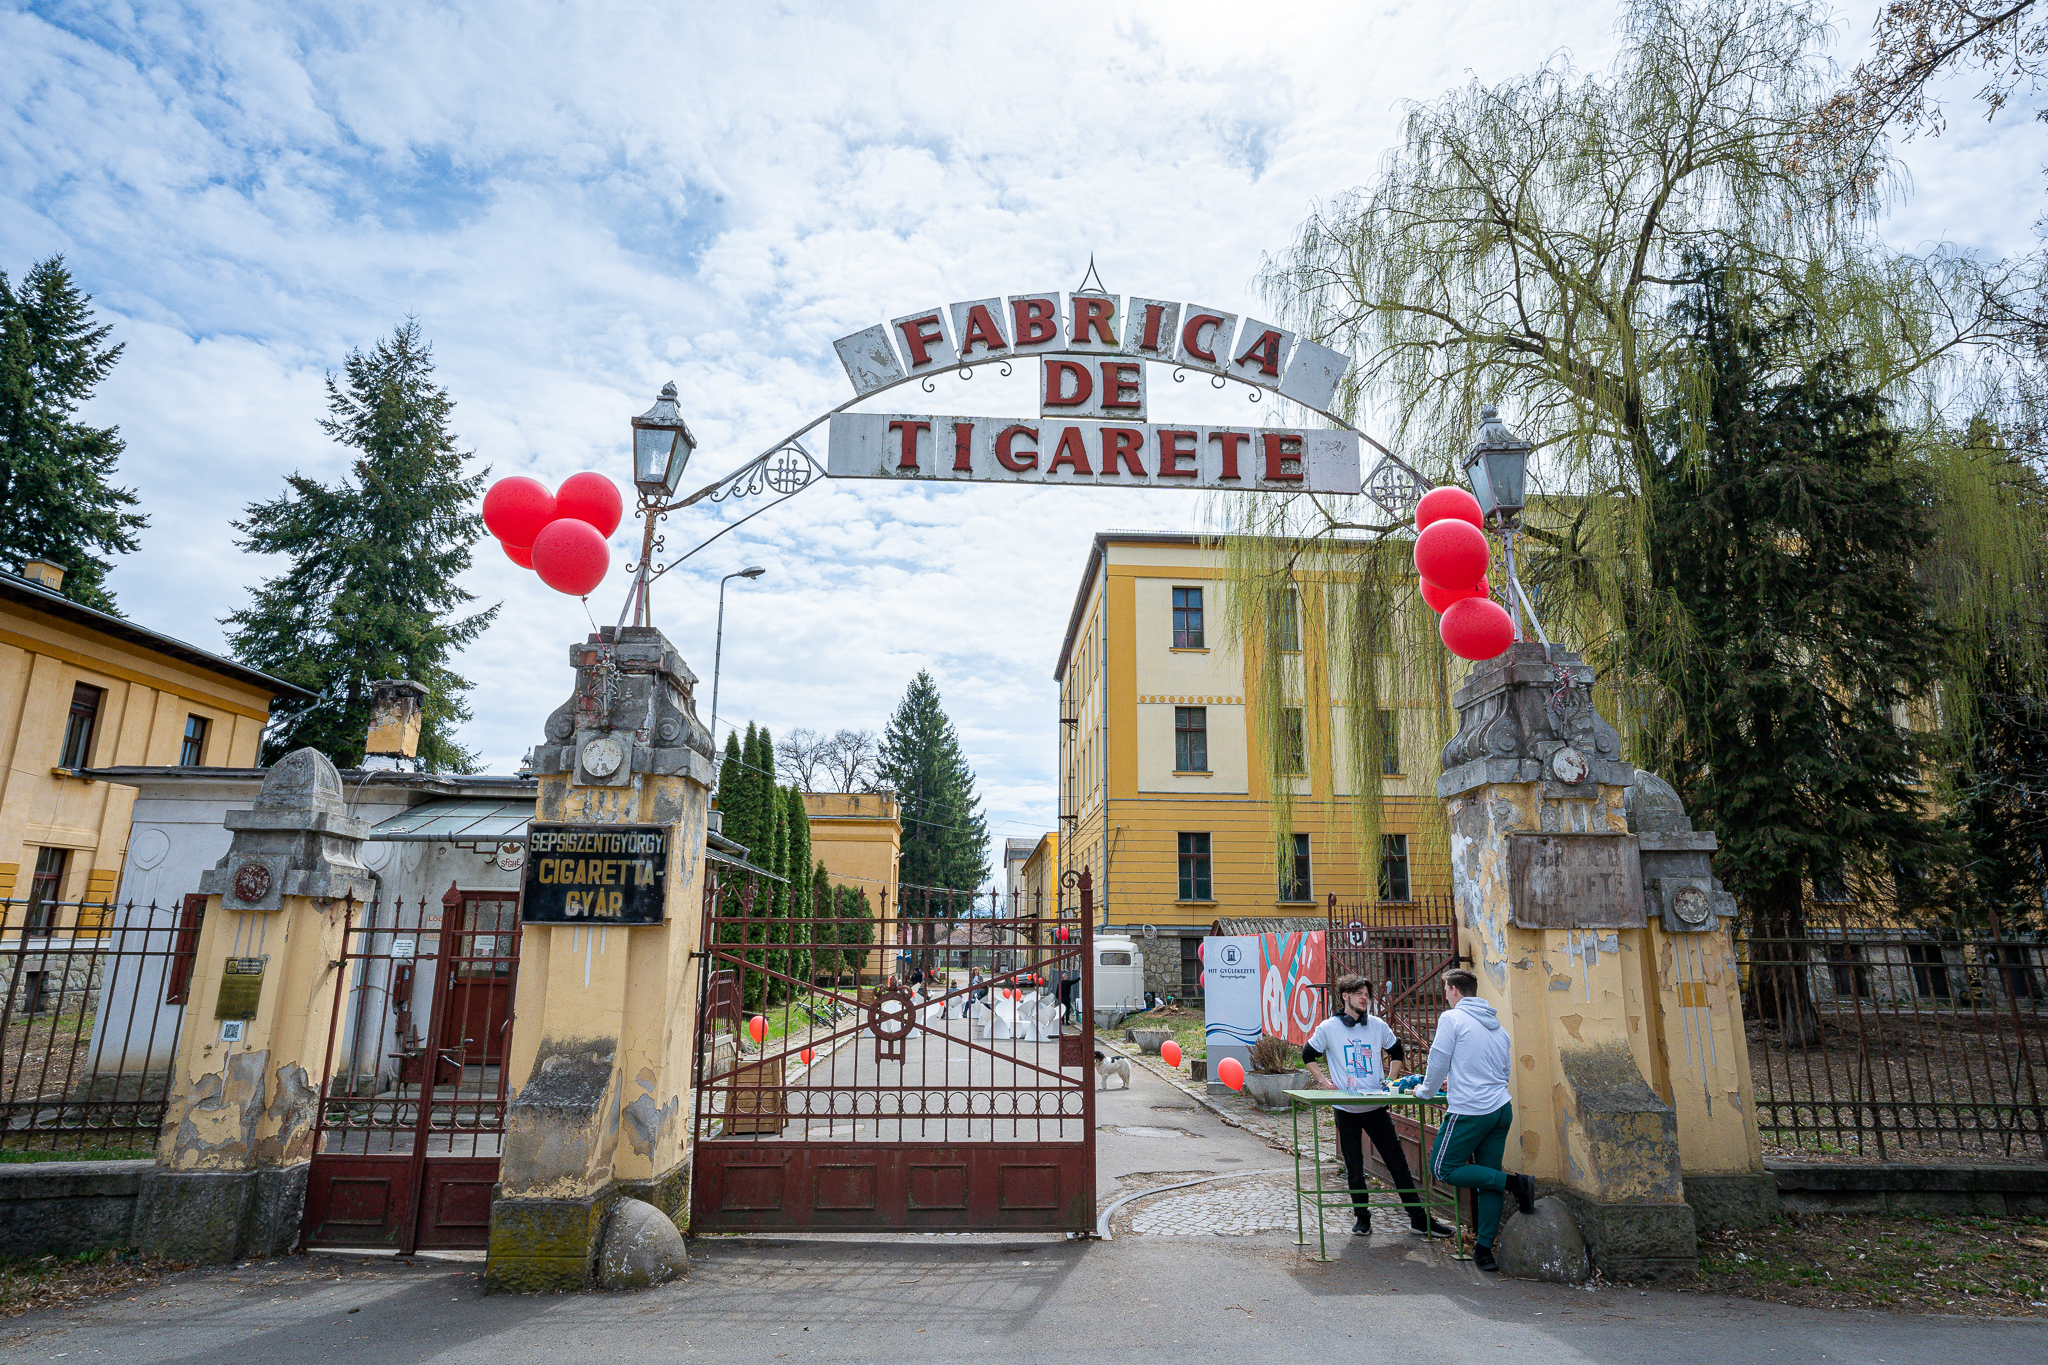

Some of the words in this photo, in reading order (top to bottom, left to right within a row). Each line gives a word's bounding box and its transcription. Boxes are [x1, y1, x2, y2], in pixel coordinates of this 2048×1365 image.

[899, 297, 1283, 377] FABRICA
[1043, 360, 1142, 409] DE
[888, 420, 1304, 481] TIGARETE
[530, 831, 667, 854] SEPSISZENTGYÖRGYI
[538, 858, 665, 886] CIGARETTA-
[564, 888, 623, 918] GYÁR
